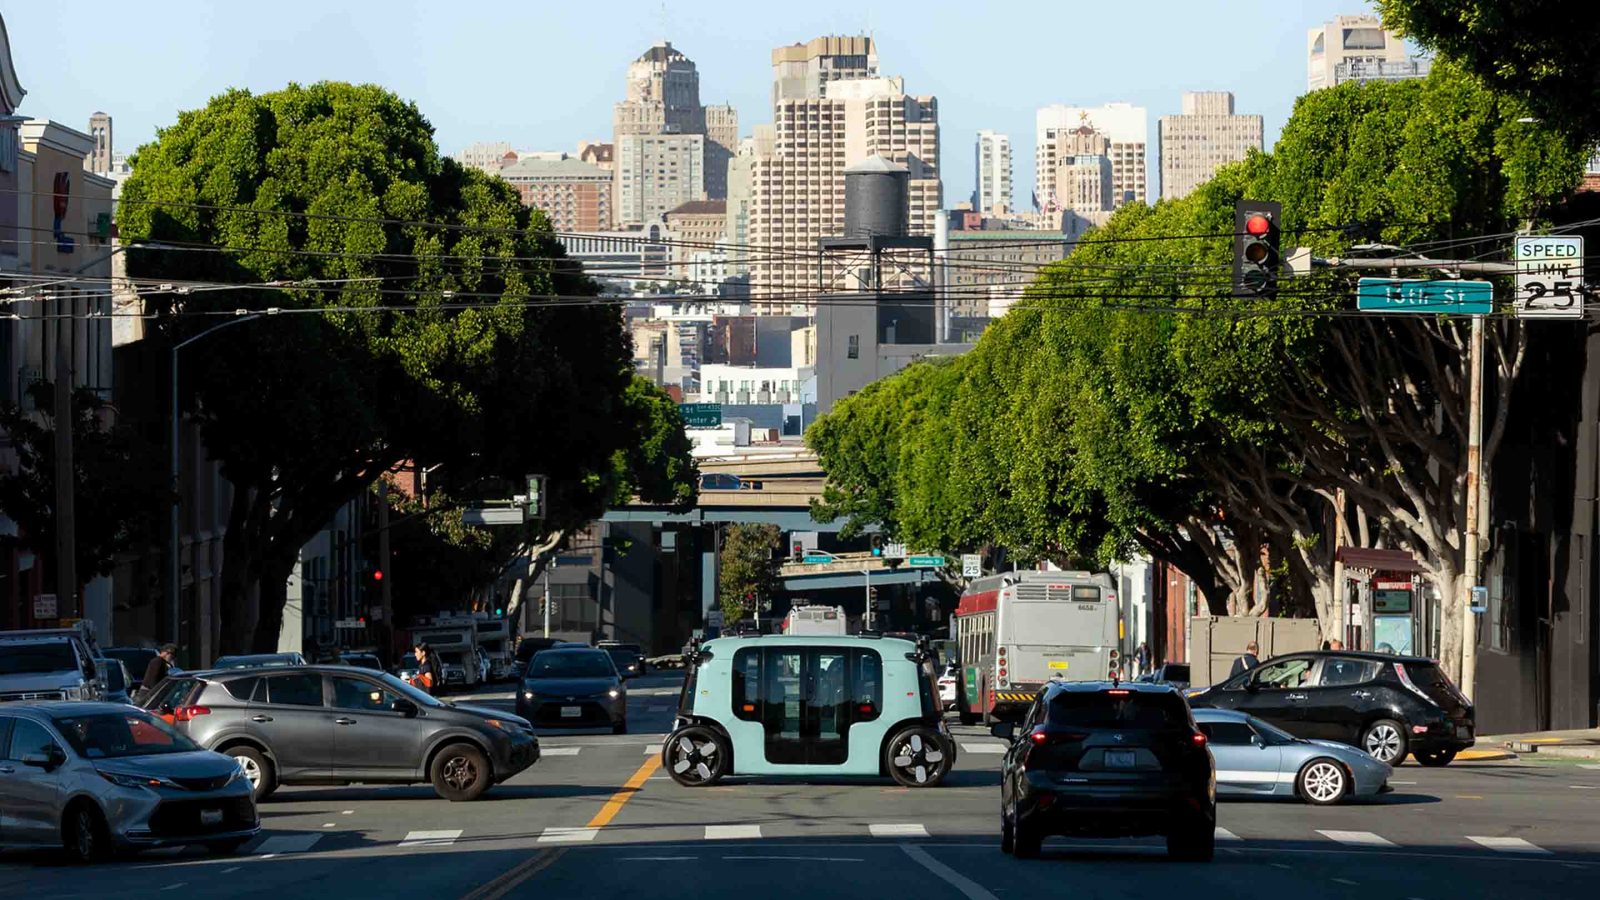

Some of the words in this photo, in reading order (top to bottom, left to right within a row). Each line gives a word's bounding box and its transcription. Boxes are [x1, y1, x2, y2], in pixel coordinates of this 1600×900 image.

[1522, 244, 1576, 257] SPEED
[1526, 263, 1572, 276] LIMIT
[1443, 289, 1466, 306] St
[1524, 281, 1575, 310] 25
[965, 566, 979, 575] 25
